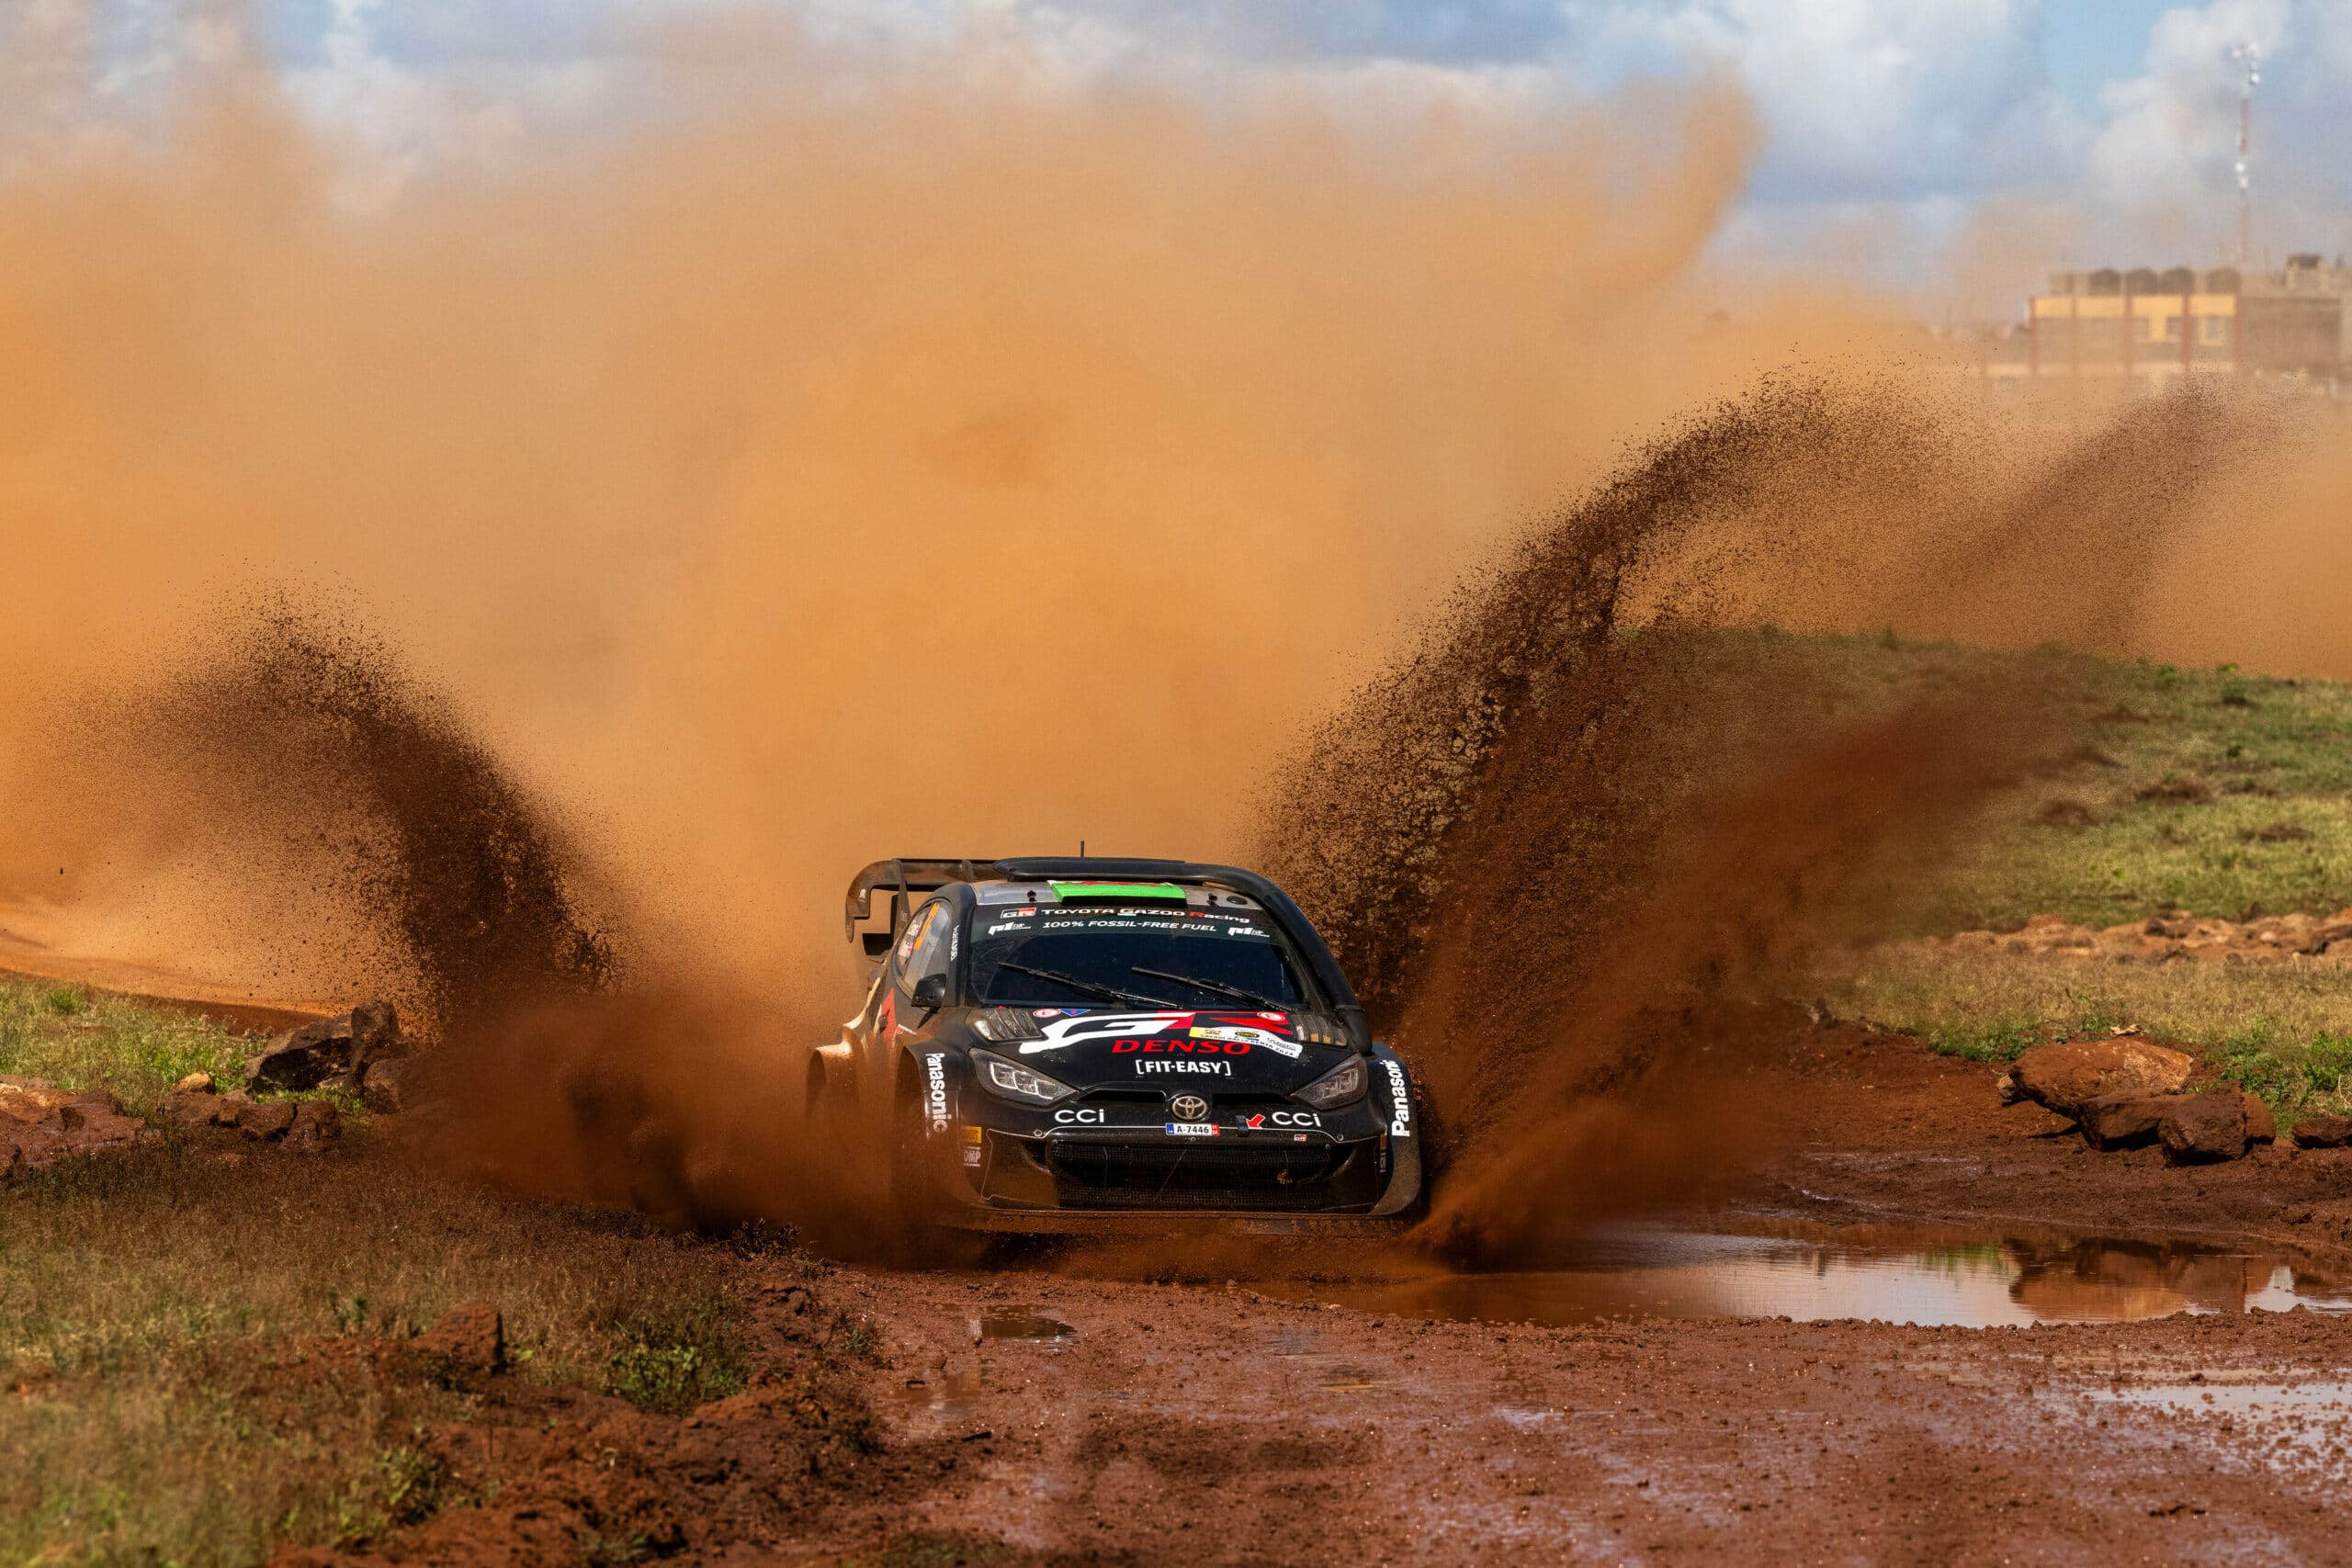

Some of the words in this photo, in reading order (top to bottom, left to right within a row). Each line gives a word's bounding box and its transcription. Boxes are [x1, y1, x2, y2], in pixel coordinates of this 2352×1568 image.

[1001, 908, 1035, 919] GR
[1119, 908, 1185, 917] GAZOO
[1190, 911, 1250, 923] Racing
[1042, 920, 1085, 929] 100%
[1088, 920, 1179, 929] FOSSIL-FREE
[1182, 923, 1217, 931] FUEL
[1112, 1039, 1251, 1055] DENSO
[925, 1053, 952, 1133] Panasonic
[1176, 1125, 1209, 1134] A-7446
